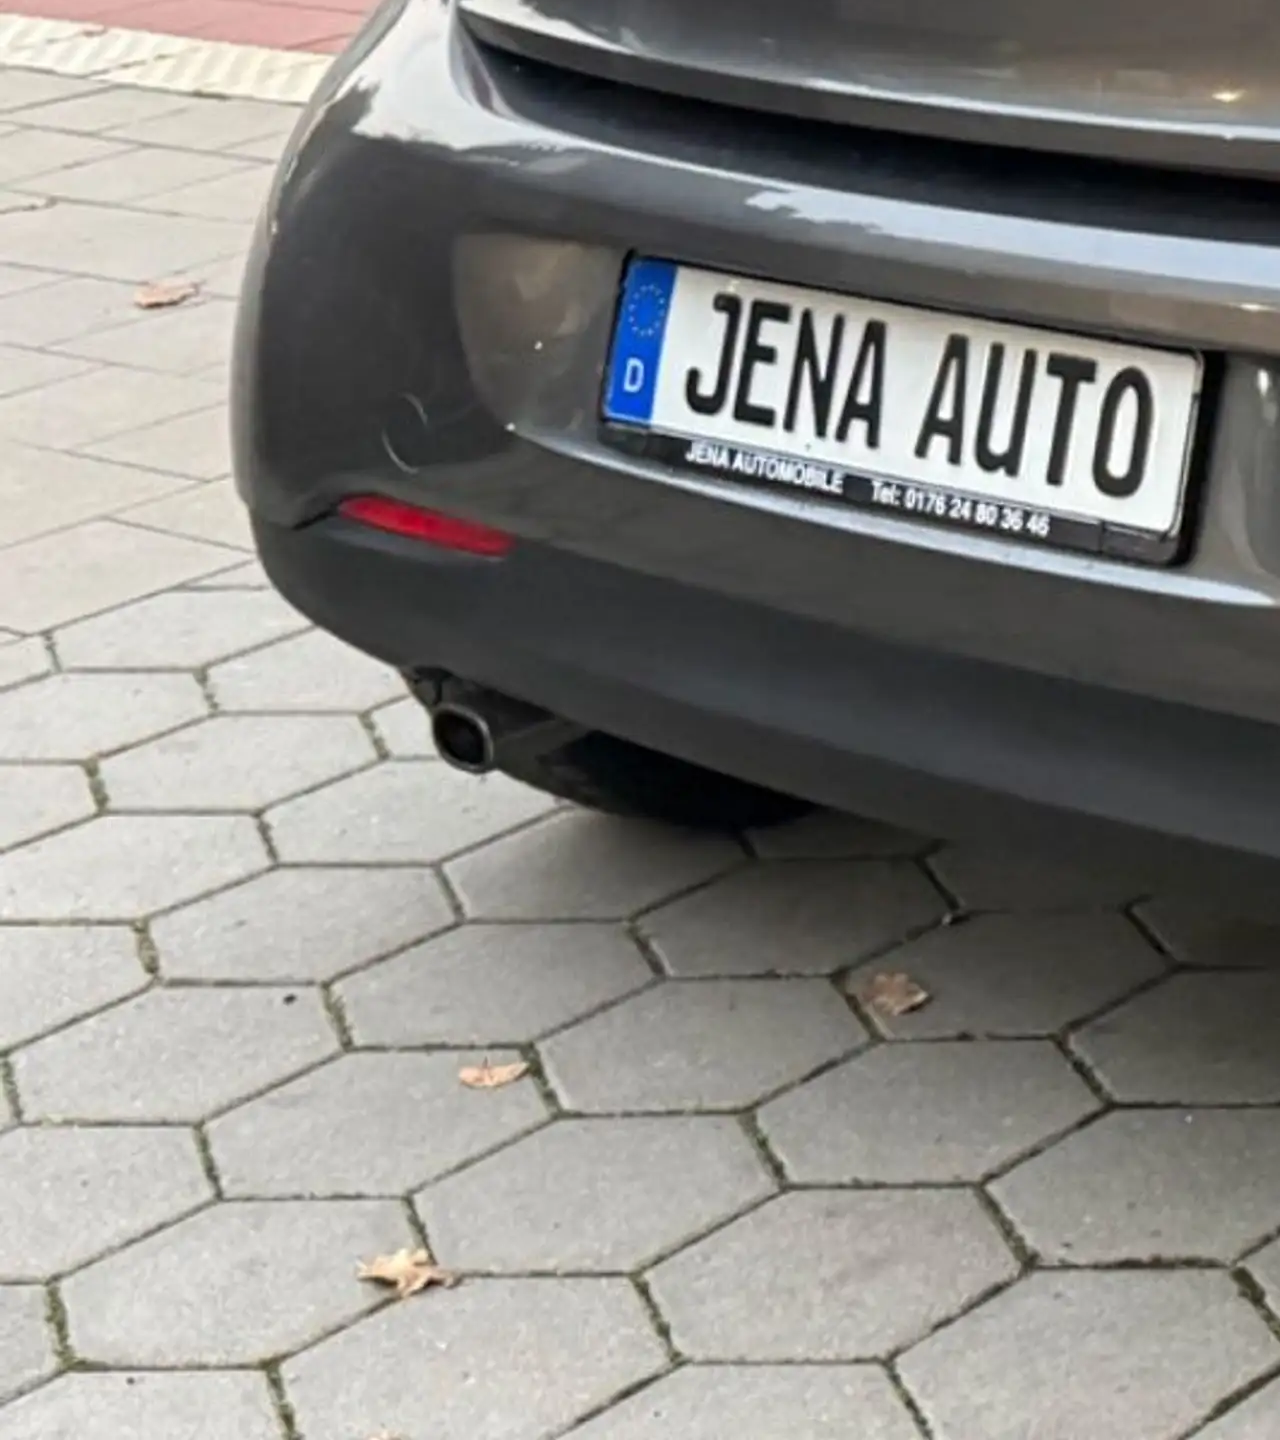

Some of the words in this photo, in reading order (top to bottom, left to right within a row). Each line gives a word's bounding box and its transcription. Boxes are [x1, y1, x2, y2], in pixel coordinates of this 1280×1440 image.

[623, 357, 645, 393] D
[685, 291, 888, 449] JENA
[914, 333, 1155, 499] AUTO
[685, 442, 731, 468] JENA
[732, 452, 844, 494] AUTOMOBILE
[904, 487, 946, 516] 0176
[949, 498, 971, 521] 24
[975, 503, 998, 526] 80
